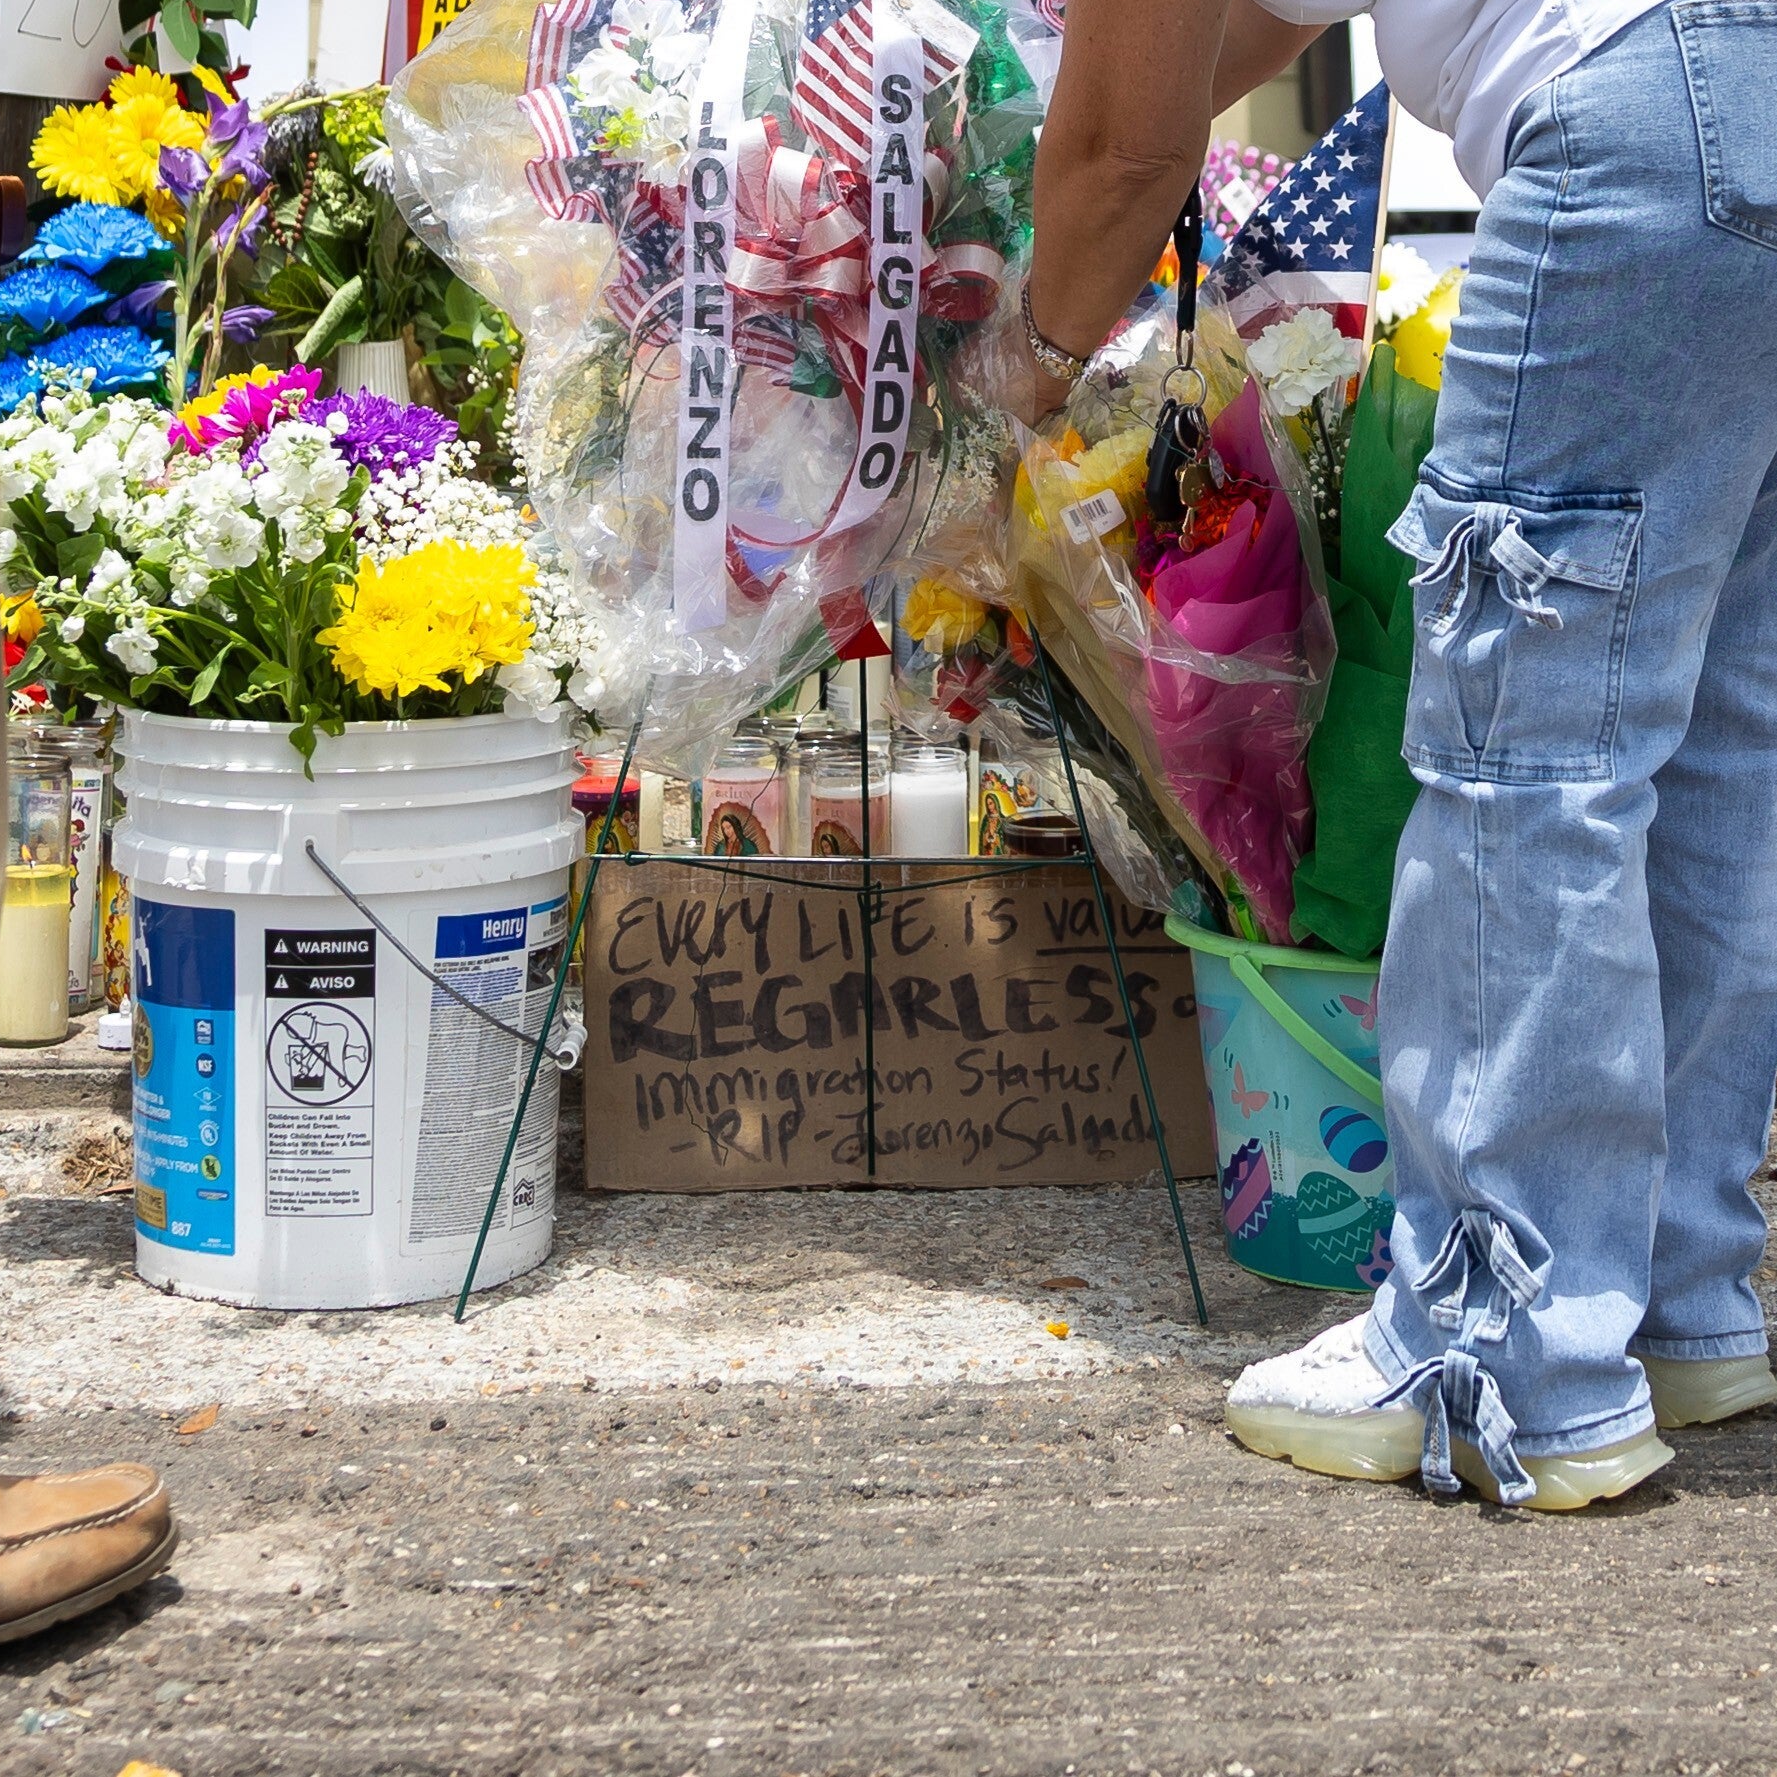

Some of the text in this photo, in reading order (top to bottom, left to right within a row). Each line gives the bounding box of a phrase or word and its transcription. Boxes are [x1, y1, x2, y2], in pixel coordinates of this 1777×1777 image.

[684, 101, 729, 522] LORENZO
[858, 74, 915, 492] SALGADO
[296, 940, 370, 954] WARNING
[482, 916, 525, 939] Henry
[309, 975, 356, 990] AVISO
[609, 970, 1160, 1063] REGARLESS
[635, 1046, 1127, 1131] Immigration Status!
